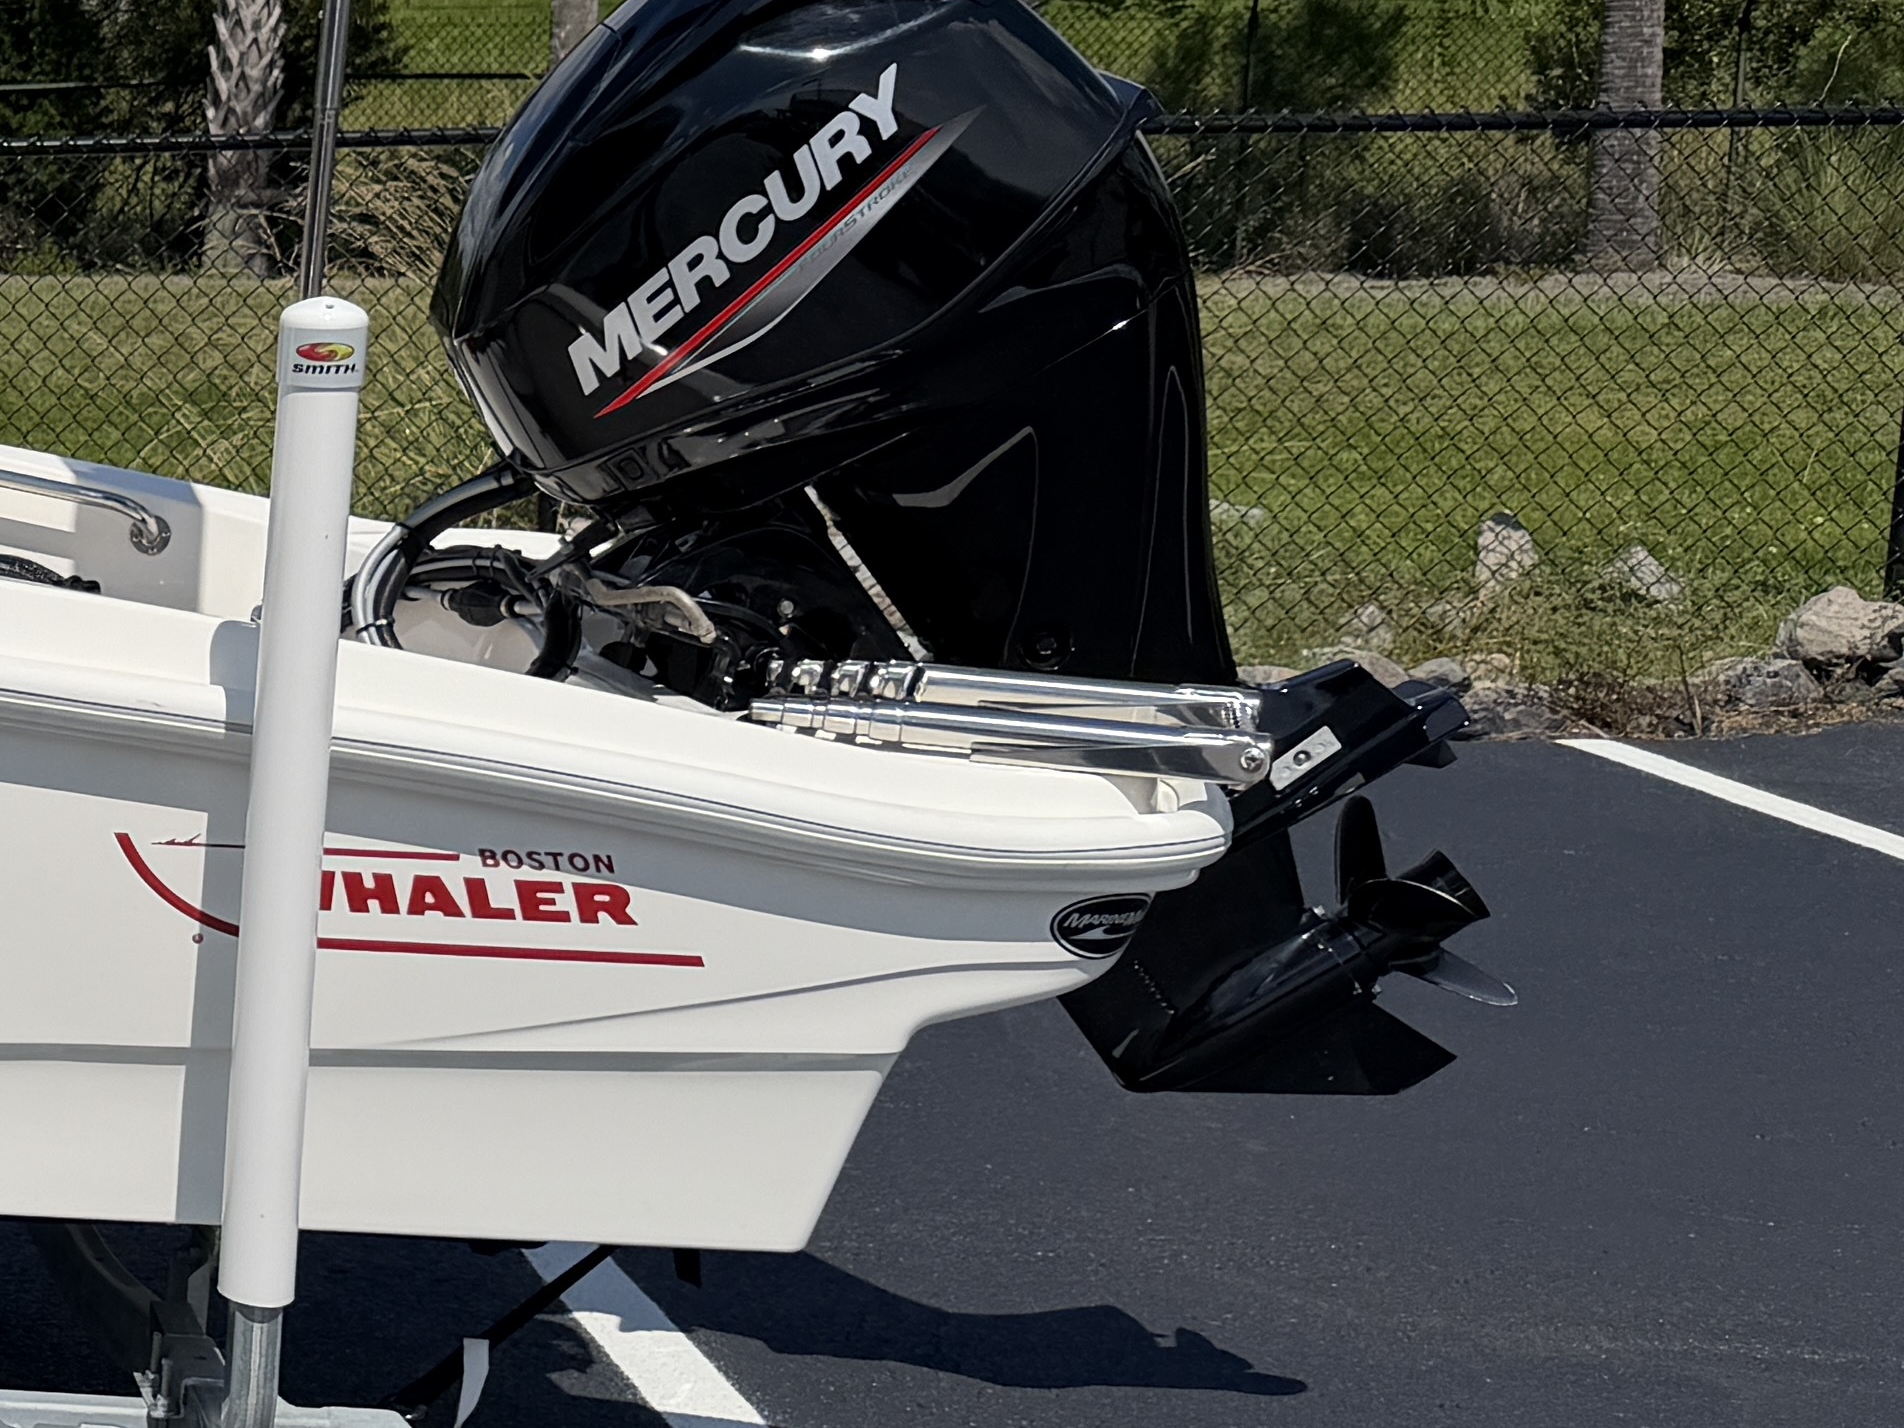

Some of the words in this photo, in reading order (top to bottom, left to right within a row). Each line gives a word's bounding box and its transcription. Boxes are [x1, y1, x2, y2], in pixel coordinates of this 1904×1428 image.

[567, 62, 898, 396] MERCURY
[292, 363, 356, 375] SMITH
[477, 848, 616, 874] BOSTON
